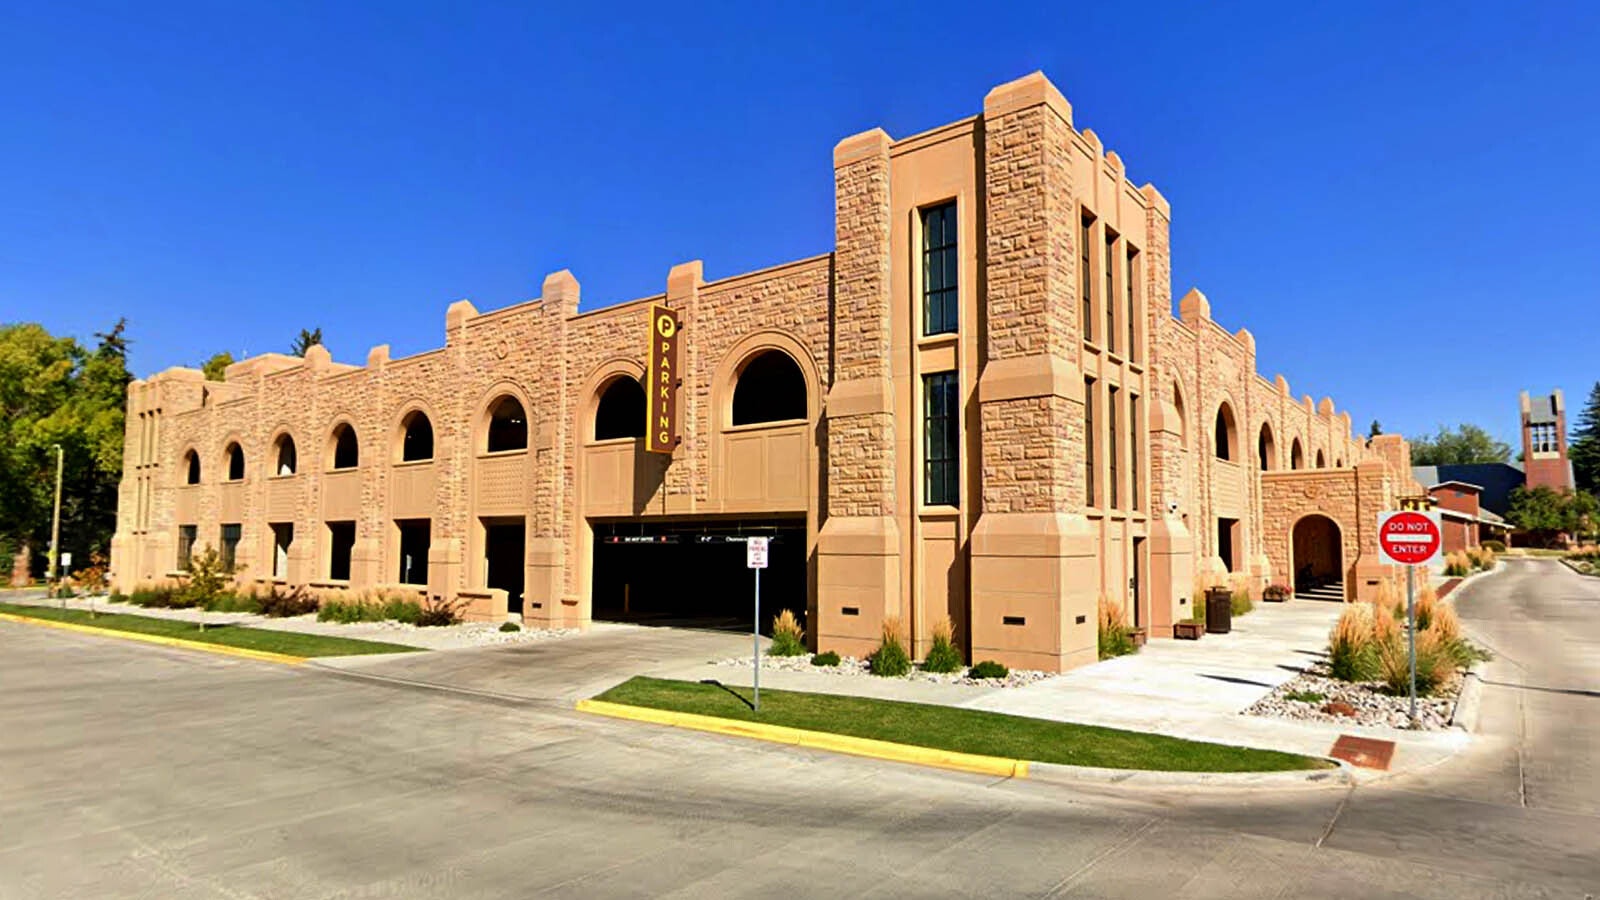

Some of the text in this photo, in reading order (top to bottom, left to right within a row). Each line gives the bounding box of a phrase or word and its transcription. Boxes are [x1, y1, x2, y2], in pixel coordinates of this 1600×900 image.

[661, 318, 671, 333] P
[660, 342, 670, 444] PARKING
[1389, 522, 1429, 532] DO NOT
[1393, 544, 1427, 554] ENTER
